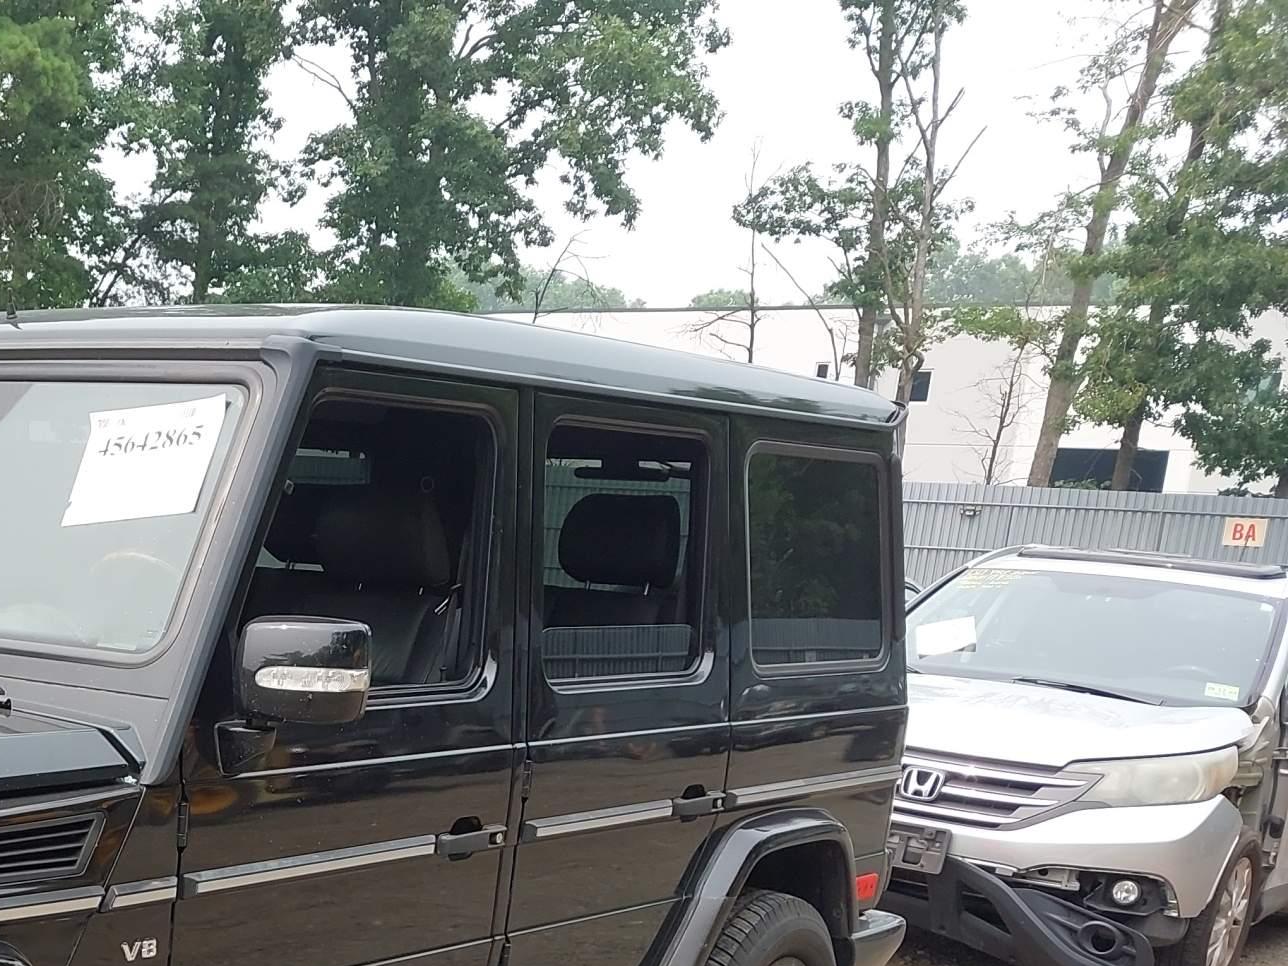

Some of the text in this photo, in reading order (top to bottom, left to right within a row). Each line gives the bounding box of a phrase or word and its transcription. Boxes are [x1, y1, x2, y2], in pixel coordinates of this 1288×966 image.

[98, 424, 204, 457] 45642865
[1231, 523, 1257, 542] BA
[120, 938, 158, 962] V8
